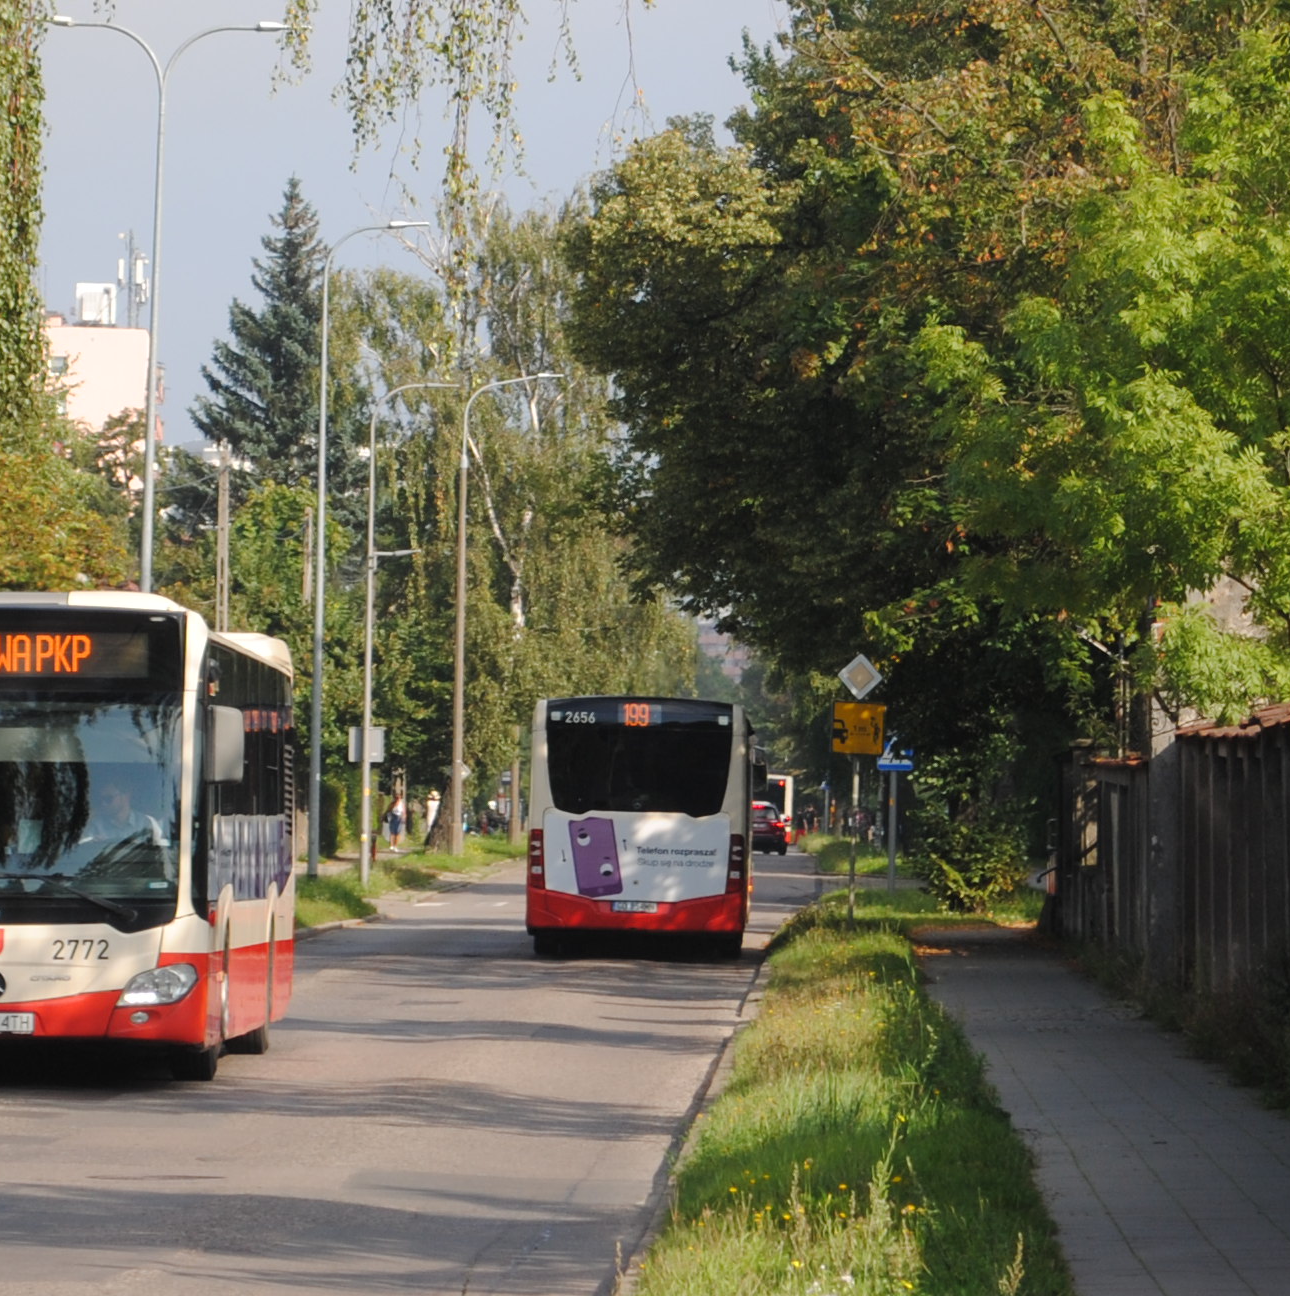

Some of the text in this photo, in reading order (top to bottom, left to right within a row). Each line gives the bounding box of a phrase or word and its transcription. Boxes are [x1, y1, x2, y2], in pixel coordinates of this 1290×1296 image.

[35, 634, 92, 672] PKP
[565, 711, 596, 724] 2656
[623, 702, 650, 727] 199
[636, 846, 668, 856] Telefon
[52, 939, 110, 960] 2772
